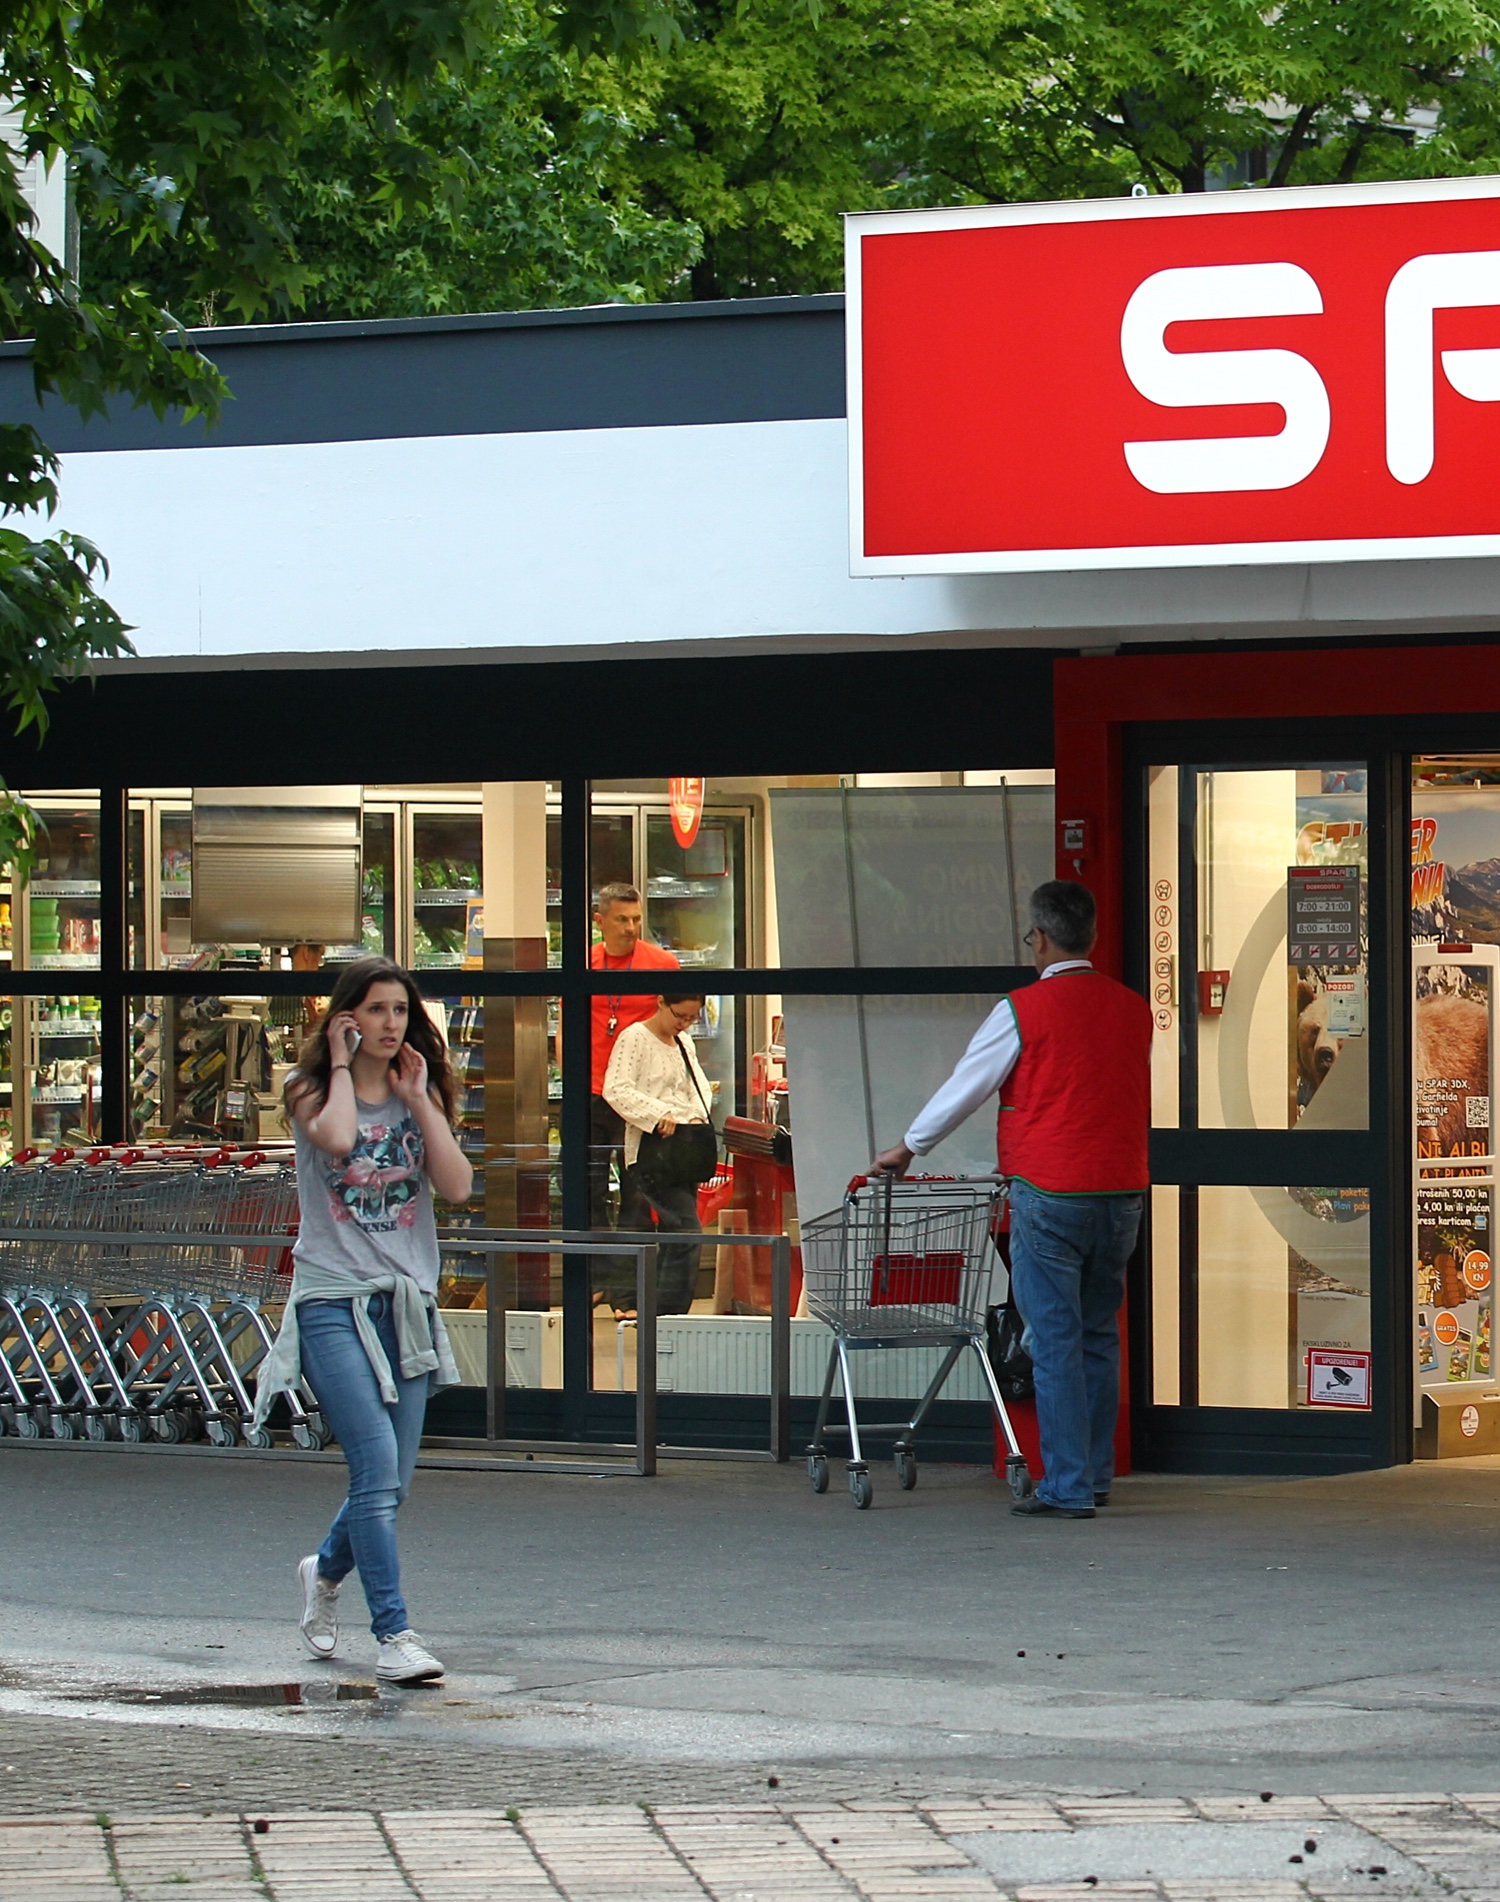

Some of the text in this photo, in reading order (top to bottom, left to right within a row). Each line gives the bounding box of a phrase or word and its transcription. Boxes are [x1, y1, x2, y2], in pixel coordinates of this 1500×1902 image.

[1320, 869, 1346, 877] SPAR
[1299, 902, 1317, 911] 7:00
[1325, 902, 1349, 911] 21:00
[1299, 924, 1317, 933] 8:00
[1326, 924, 1350, 932] 14:00
[1426, 1079, 1448, 1088] SPAR
[1422, 1091, 1458, 1101] Garfielda
[1452, 1188, 1476, 1200] 50,00
[1478, 1189, 1488, 1199] kn
[1333, 1200, 1351, 1210] Plavi
[1444, 1202, 1454, 1212] kn
[1456, 1202, 1464, 1212] ili
[1438, 1215, 1472, 1227] karticom
[1472, 1272, 1484, 1282] KN
[1303, 1340, 1343, 1348] EKSKLUZIVNO
[1321, 1357, 1359, 1366] UPOZORENJE!
